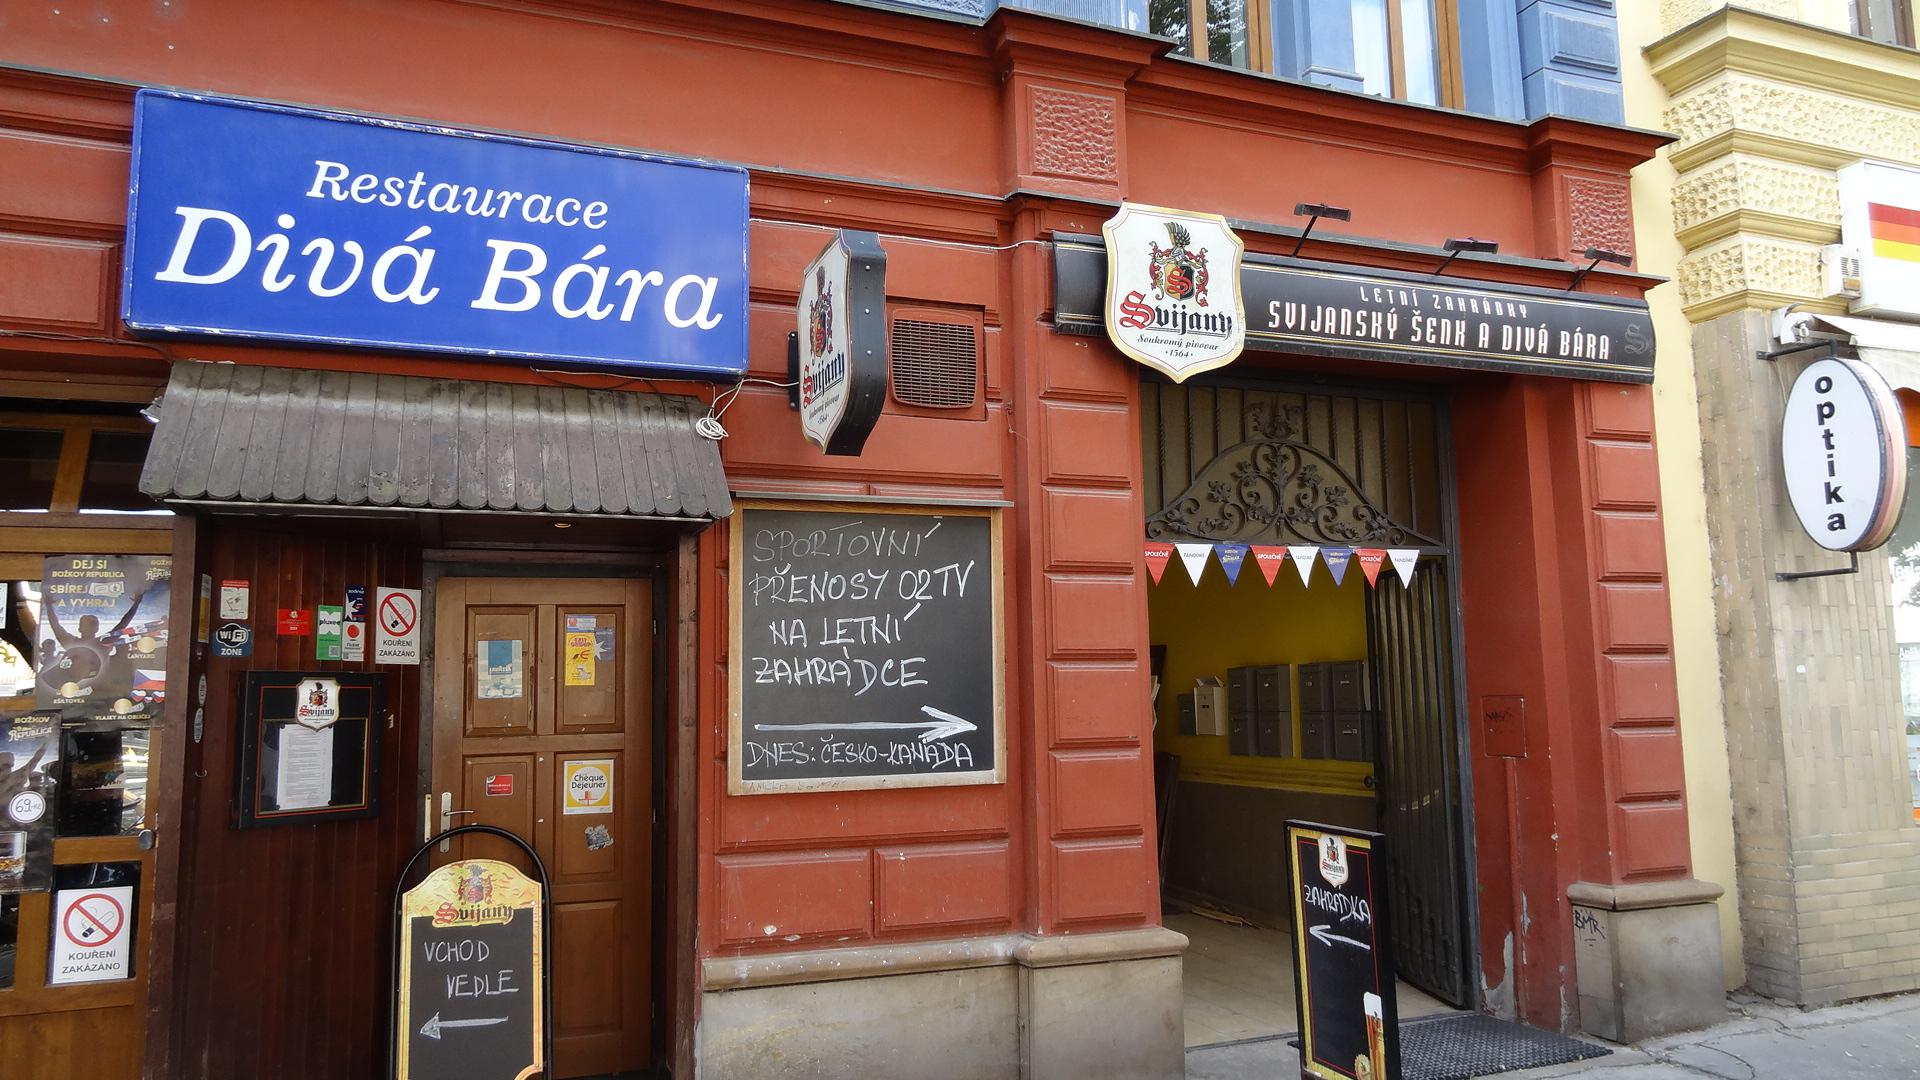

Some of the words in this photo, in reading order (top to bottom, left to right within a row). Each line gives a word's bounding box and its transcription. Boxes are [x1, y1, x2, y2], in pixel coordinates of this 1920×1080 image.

[306, 160, 609, 230] Restaurace
[155, 206, 440, 306] Divá
[471, 238, 723, 331] Bára
[1119, 291, 1232, 340] Svijany
[1360, 286, 1418, 307] LETNÍ
[1432, 294, 1527, 318] ZAHRÁDKY
[1138, 334, 1182, 348] Soukromý
[1186, 340, 1219, 351] pivovar
[1268, 300, 1398, 340] SVIJANSKÝ
[1411, 310, 1466, 347] ŠENK
[1478, 323, 1489, 349] A
[1502, 323, 1548, 354] DIVÁ
[1560, 327, 1609, 360] BÁRA
[803, 352, 845, 408] Svijany
[1814, 375, 1847, 531] optika
[753, 521, 941, 562] SPORTOVNÍ
[52, 570, 86, 578] BOŽKOV
[72, 560, 93, 569] DEJ
[96, 560, 107, 569] SI
[50, 583, 89, 594] SBÍREJ
[748, 563, 889, 606] PŘENOSY
[58, 599, 66, 607] A
[70, 599, 116, 608] VYHRAJ
[769, 618, 807, 648] NA
[820, 602, 922, 645] LETNÍ
[379, 649, 416, 657] ZAKÁZÁNO
[382, 638, 413, 647] KOUŘENÍ
[752, 646, 929, 696] ZAHRÁDCE
[14, 716, 50, 724] BOŽKOV
[433, 901, 514, 924] Svijany
[1304, 884, 1371, 925] ZAHRÁDKA
[68, 949, 116, 961] KOUŘENÍ
[424, 939, 490, 962] VCHOD
[62, 961, 121, 974] ZAKÁZÁNO
[446, 969, 519, 999] VEDLE
